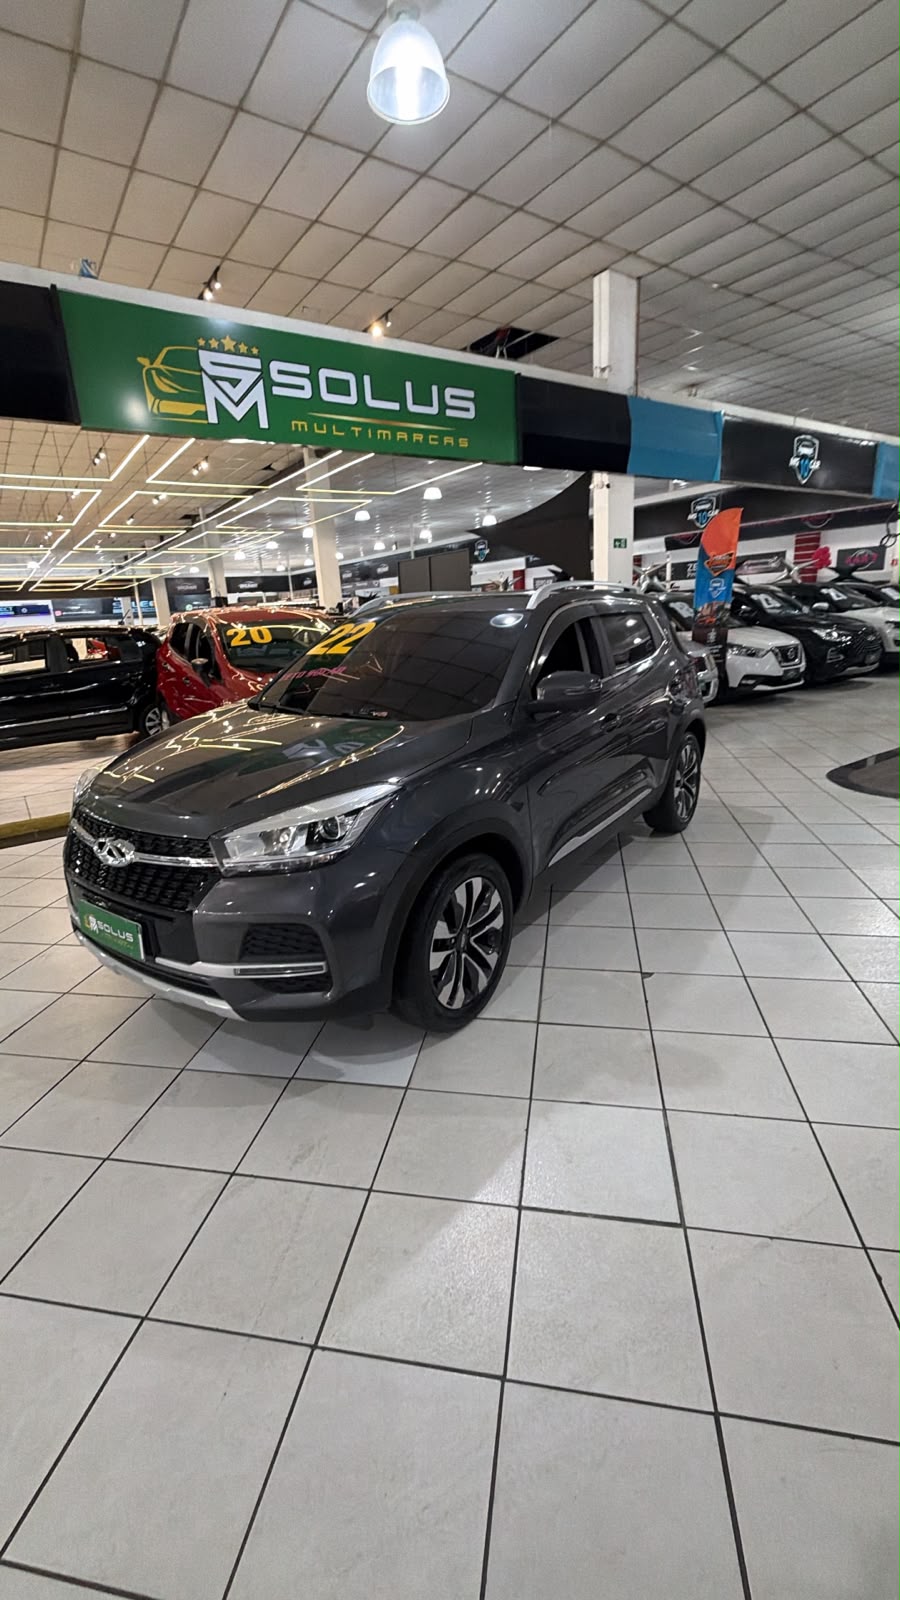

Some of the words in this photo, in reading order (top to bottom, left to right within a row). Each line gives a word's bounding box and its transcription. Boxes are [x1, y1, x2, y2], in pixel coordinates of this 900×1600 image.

[269, 360, 476, 420] SOLUS
[291, 419, 469, 448] MULTIMARCAS
[226, 626, 273, 646] 20
[306, 622, 376, 655] 22
[97, 920, 134, 943] SOLUS
